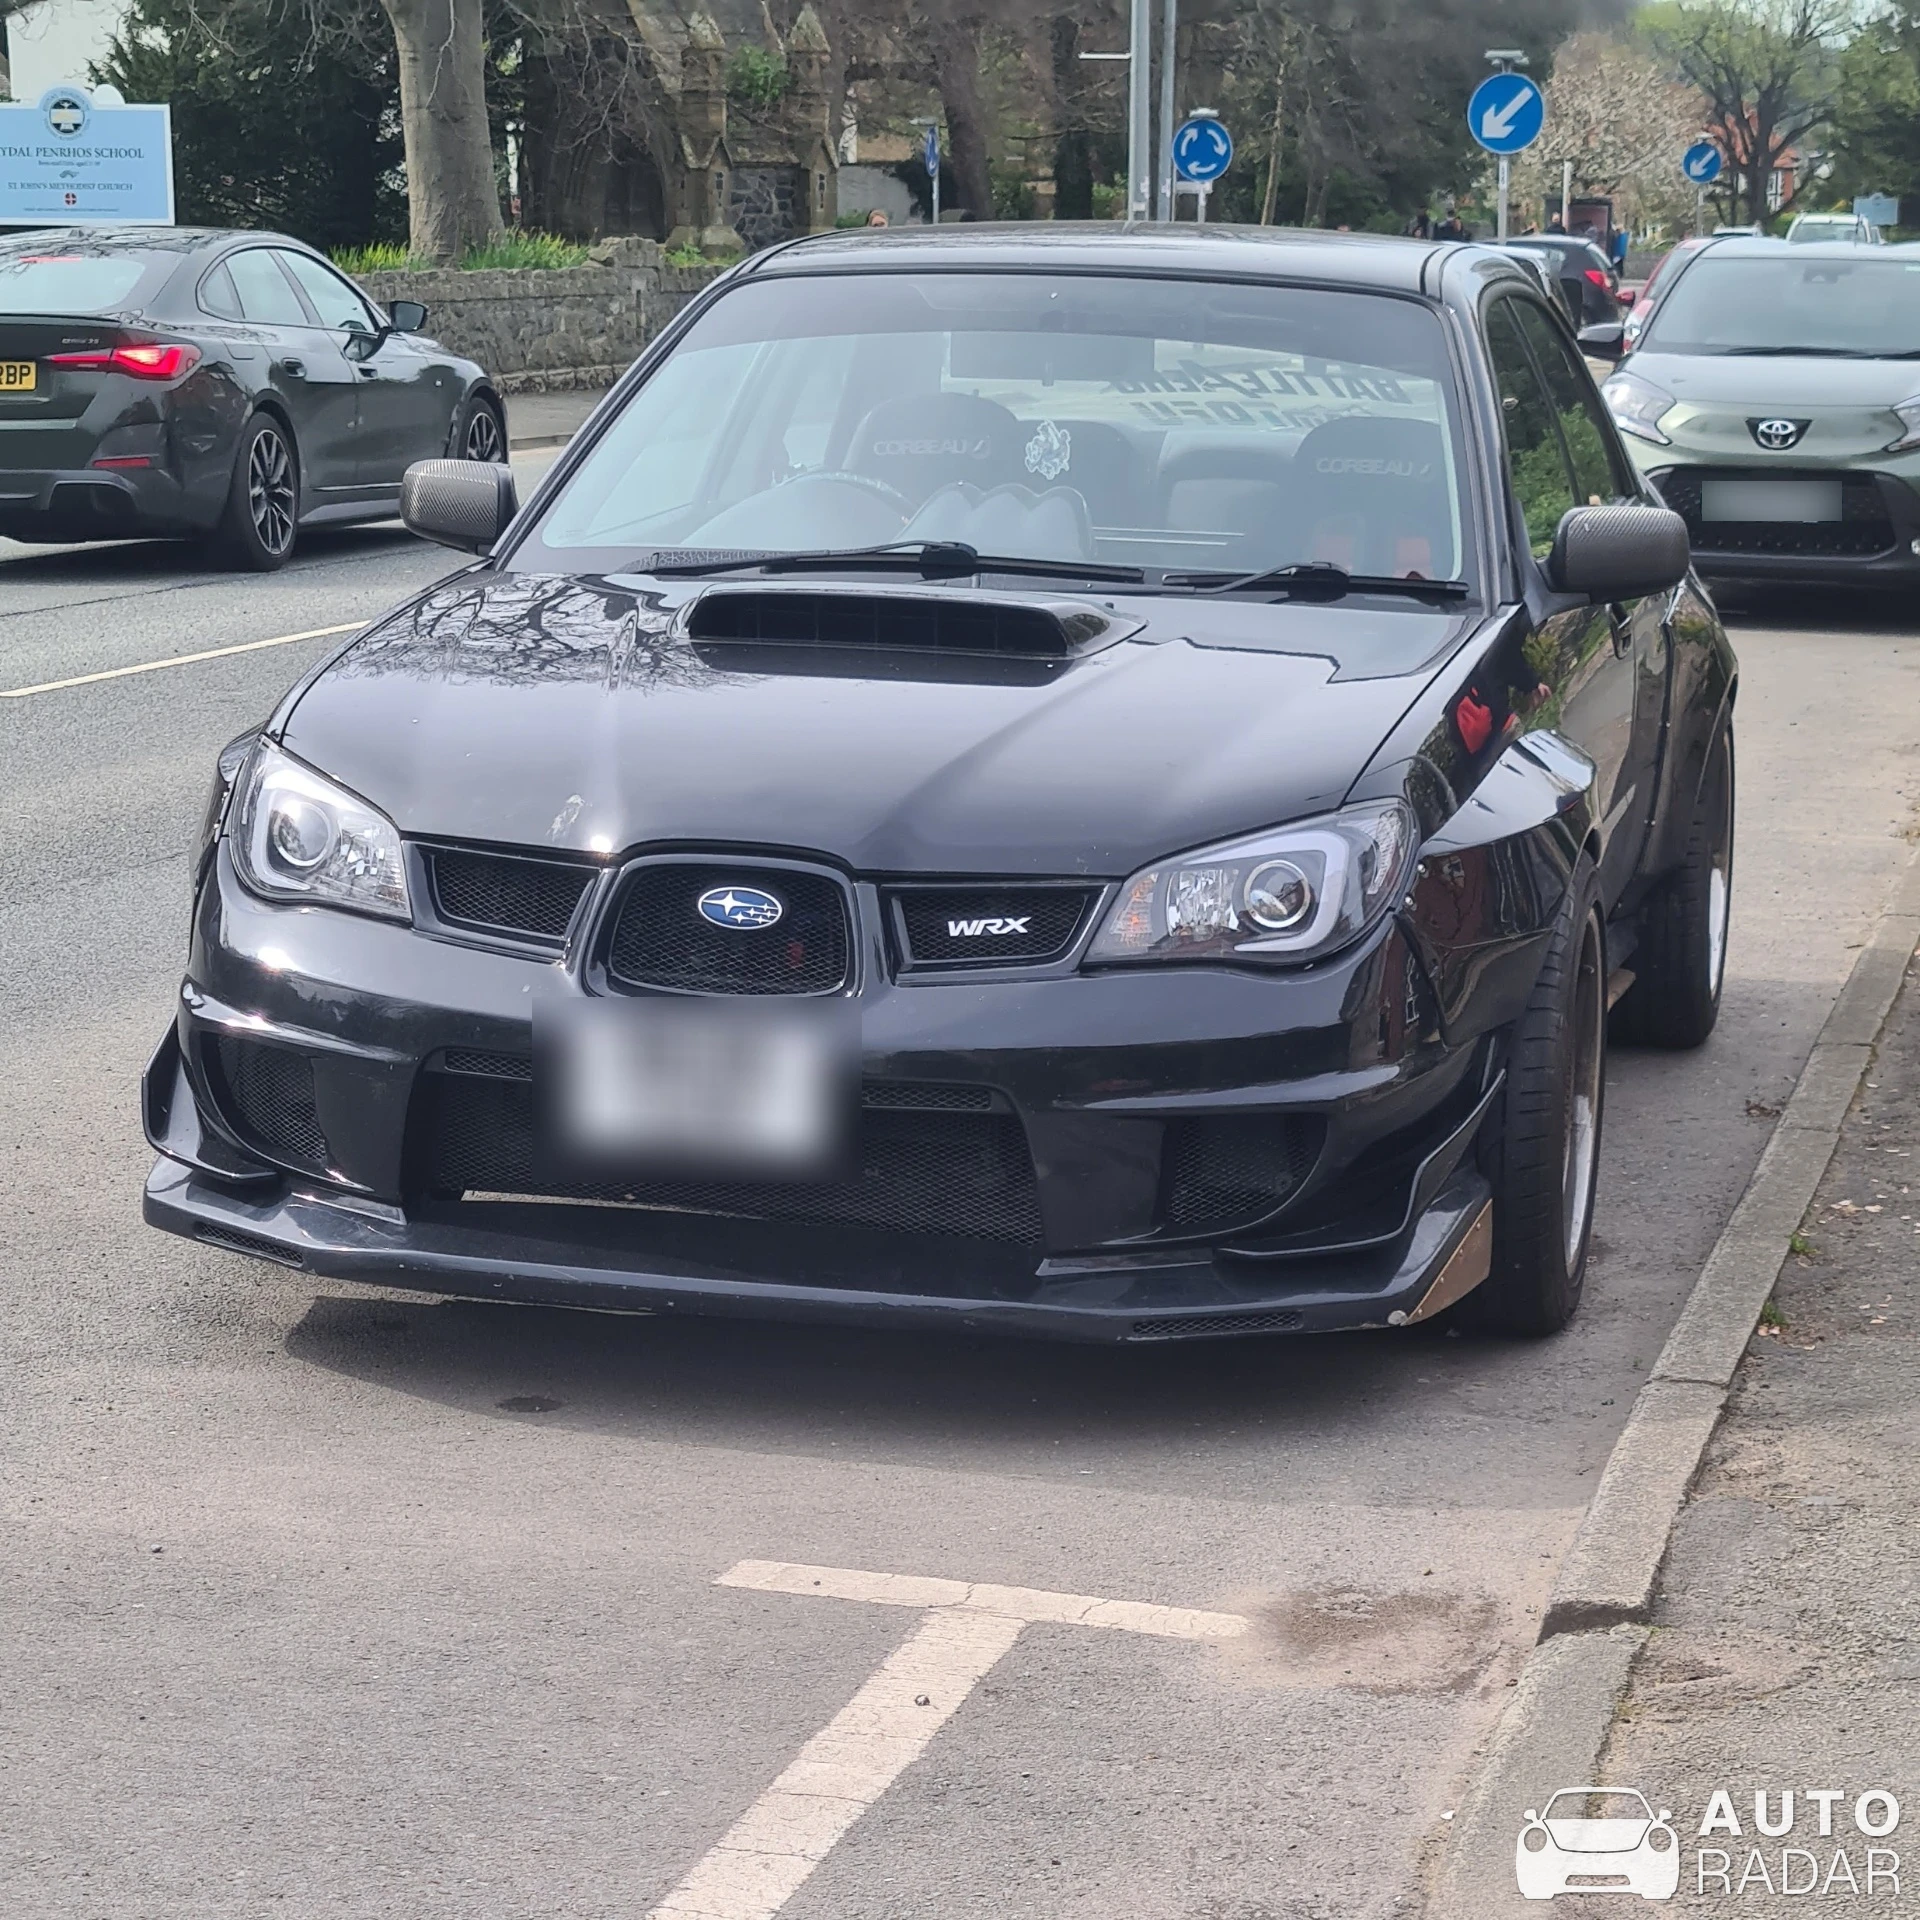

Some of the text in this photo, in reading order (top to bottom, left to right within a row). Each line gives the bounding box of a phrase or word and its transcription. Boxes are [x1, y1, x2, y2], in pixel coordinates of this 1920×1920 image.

[35, 147, 92, 158] PENRHOS
[94, 148, 144, 159] SCHOOL
[947, 917, 1031, 937] WRX
